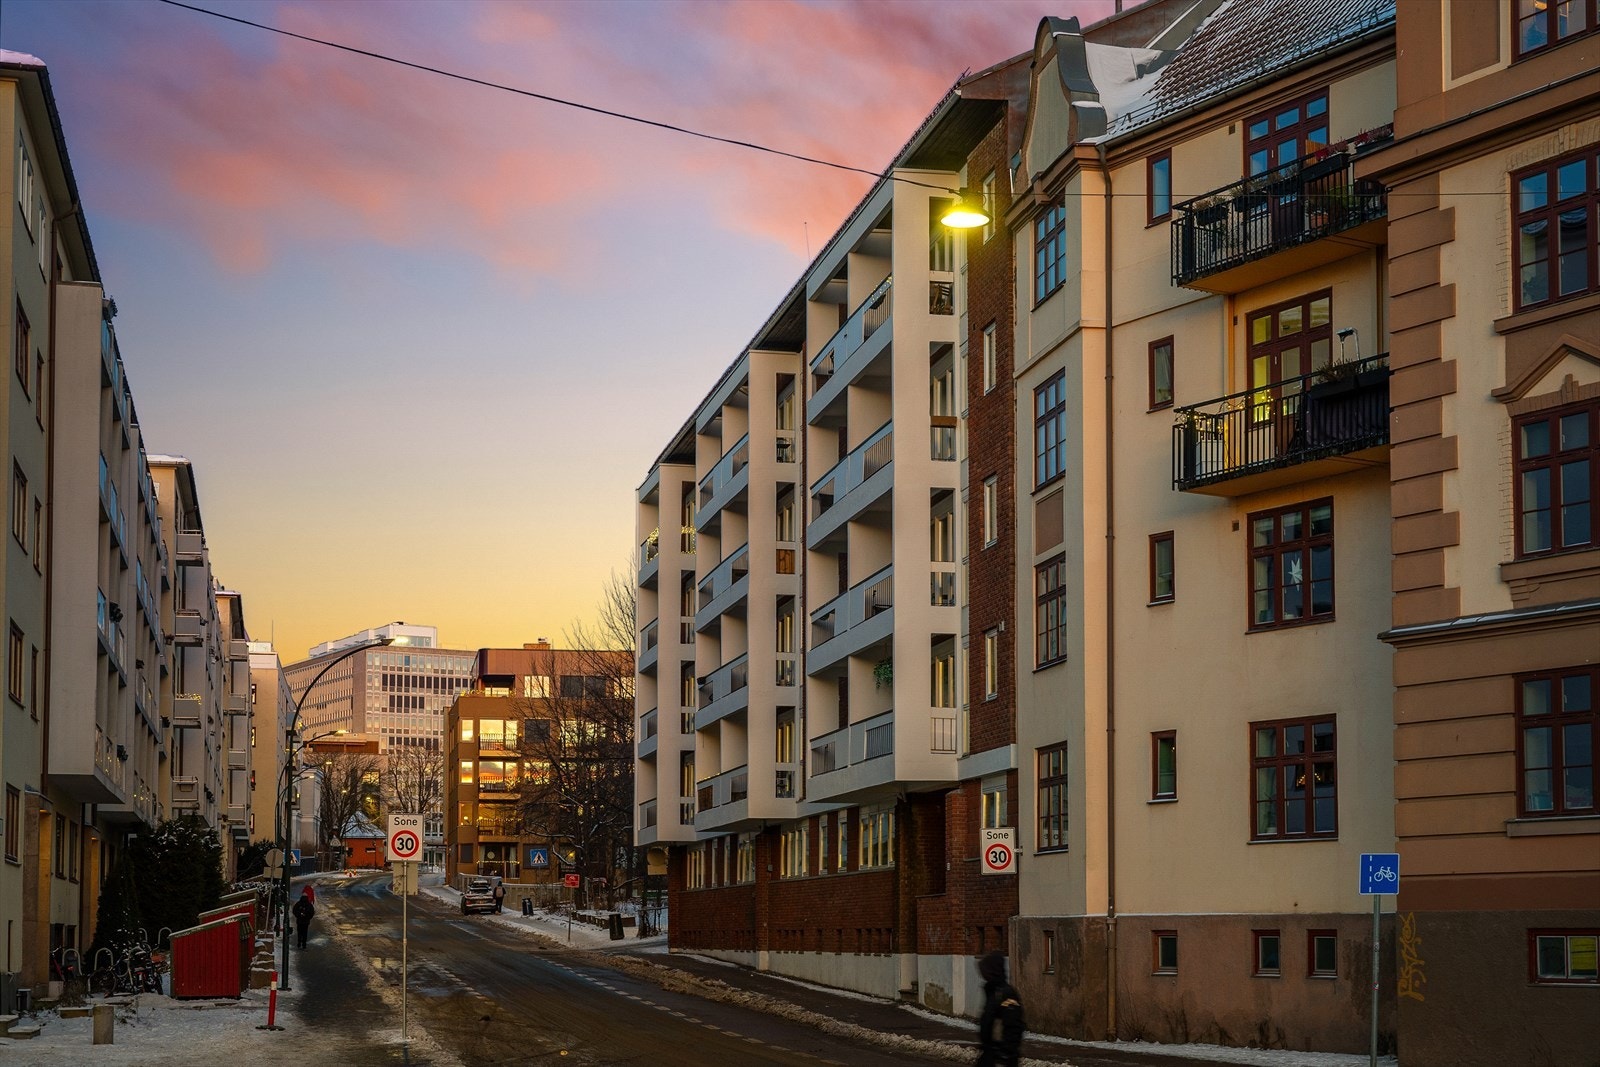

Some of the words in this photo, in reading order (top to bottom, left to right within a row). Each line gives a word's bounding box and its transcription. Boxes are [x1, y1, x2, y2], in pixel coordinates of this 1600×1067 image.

[394, 817, 418, 826] Sone
[986, 831, 1009, 839] Sone
[397, 838, 414, 850] 30
[990, 851, 1007, 863] 30
